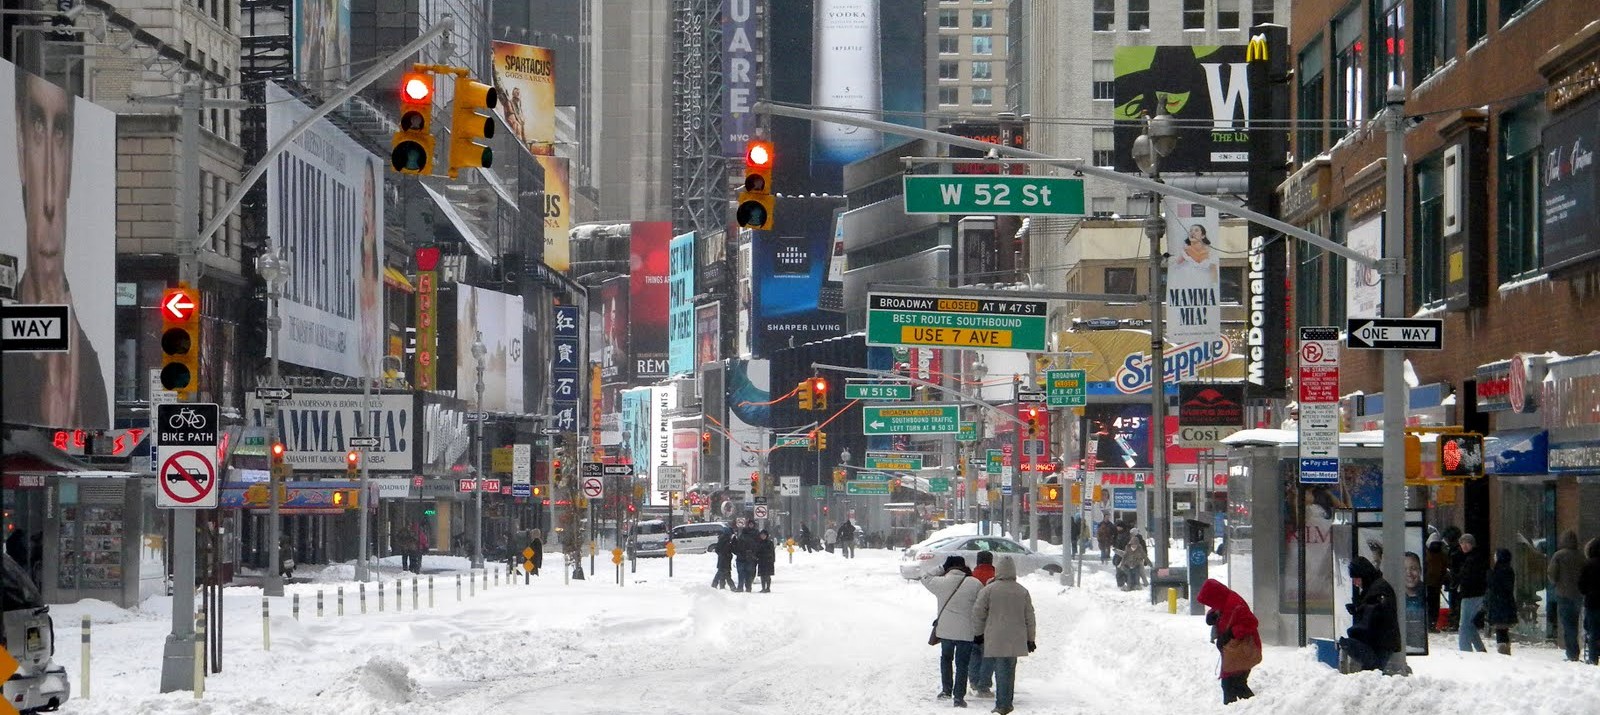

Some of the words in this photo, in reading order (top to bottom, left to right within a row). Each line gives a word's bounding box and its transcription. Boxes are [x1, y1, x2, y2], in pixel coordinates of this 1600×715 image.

[504, 54, 550, 76] SPARTACUS
[1211, 132, 1232, 142] THE
[940, 184, 962, 206] W
[974, 184, 1010, 206] 52
[1022, 184, 1052, 206] St
[646, 276, 663, 284] THINGS
[1170, 288, 1216, 307] MAMMA
[880, 298, 934, 309] BROADWAY
[939, 300, 977, 310] CLOSED
[982, 302, 994, 312] AT
[998, 303, 1008, 312] W
[1009, 304, 1022, 312] 47
[1024, 304, 1037, 313] ST
[892, 314, 916, 324] BEST
[920, 315, 952, 325] ROUTE
[956, 317, 1022, 328] SOUTHBOUND
[1180, 307, 1208, 326] MIA!
[12, 320, 52, 337] WAY
[1362, 328, 1388, 340] ONE
[1402, 328, 1430, 340] WAY
[914, 329, 944, 342] USE
[952, 330, 960, 342] 7
[969, 331, 1000, 344] AVE
[860, 388, 868, 396] W
[872, 388, 883, 396] 51
[886, 388, 897, 396] St
[53, 428, 144, 456] ROST
[162, 432, 185, 442] BIKE
[188, 432, 213, 442] PATH
[462, 480, 498, 490] FAMIA
